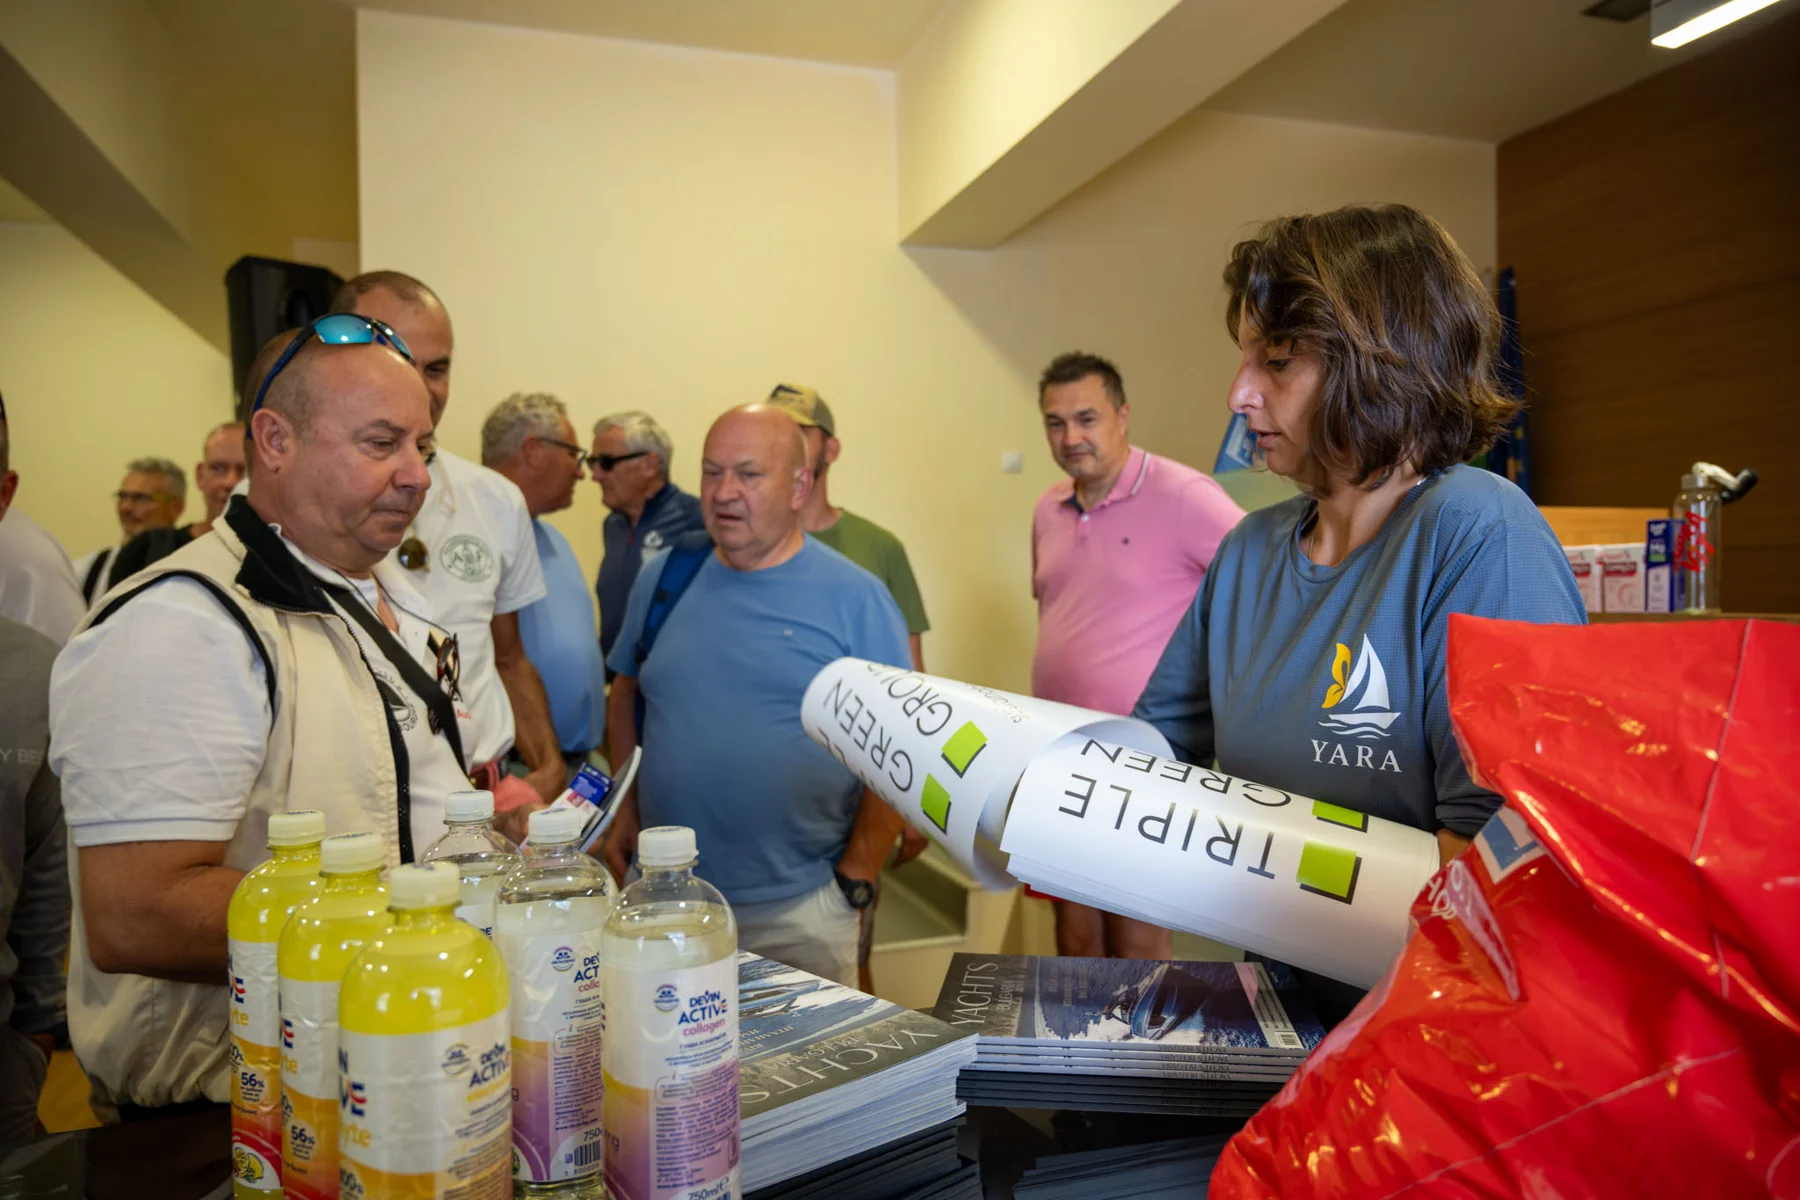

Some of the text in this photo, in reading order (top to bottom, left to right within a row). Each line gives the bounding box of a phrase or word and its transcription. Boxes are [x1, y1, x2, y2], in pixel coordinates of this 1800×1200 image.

[823, 679, 913, 792] GREEN
[1311, 739, 1402, 773] YARA
[1081, 738, 1291, 808] GREEN
[1058, 772, 1275, 880] TRIPLE
[689, 989, 721, 1008] DEVIN
[950, 962, 999, 1025] YACHTS
[678, 998, 728, 1025] ACTIVE
[683, 1018, 726, 1037] collagen
[241, 1072, 265, 1088] 56%
[290, 1125, 316, 1145] 56%
[583, 1127, 602, 1142] 750
